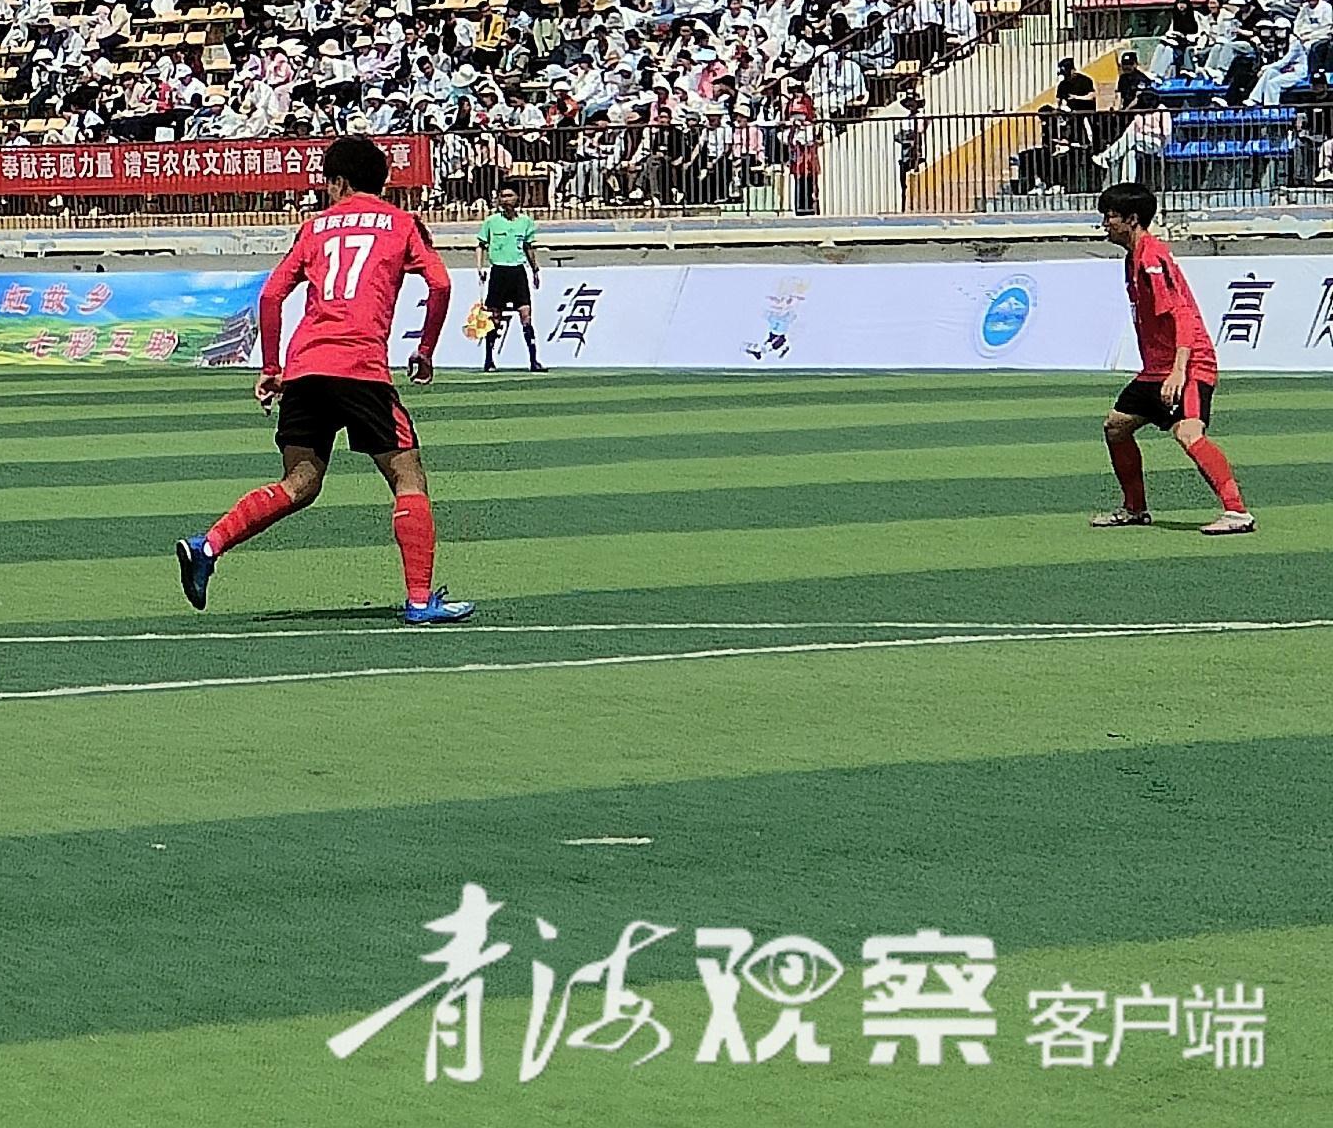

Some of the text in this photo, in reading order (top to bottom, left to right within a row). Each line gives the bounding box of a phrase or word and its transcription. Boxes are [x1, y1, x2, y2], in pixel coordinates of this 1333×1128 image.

[1, 143, 412, 180] 奉献志愿力量 谱写农体文旅商融合发章
[323, 234, 375, 301] 17
[26, 328, 180, 361] 七彩互助
